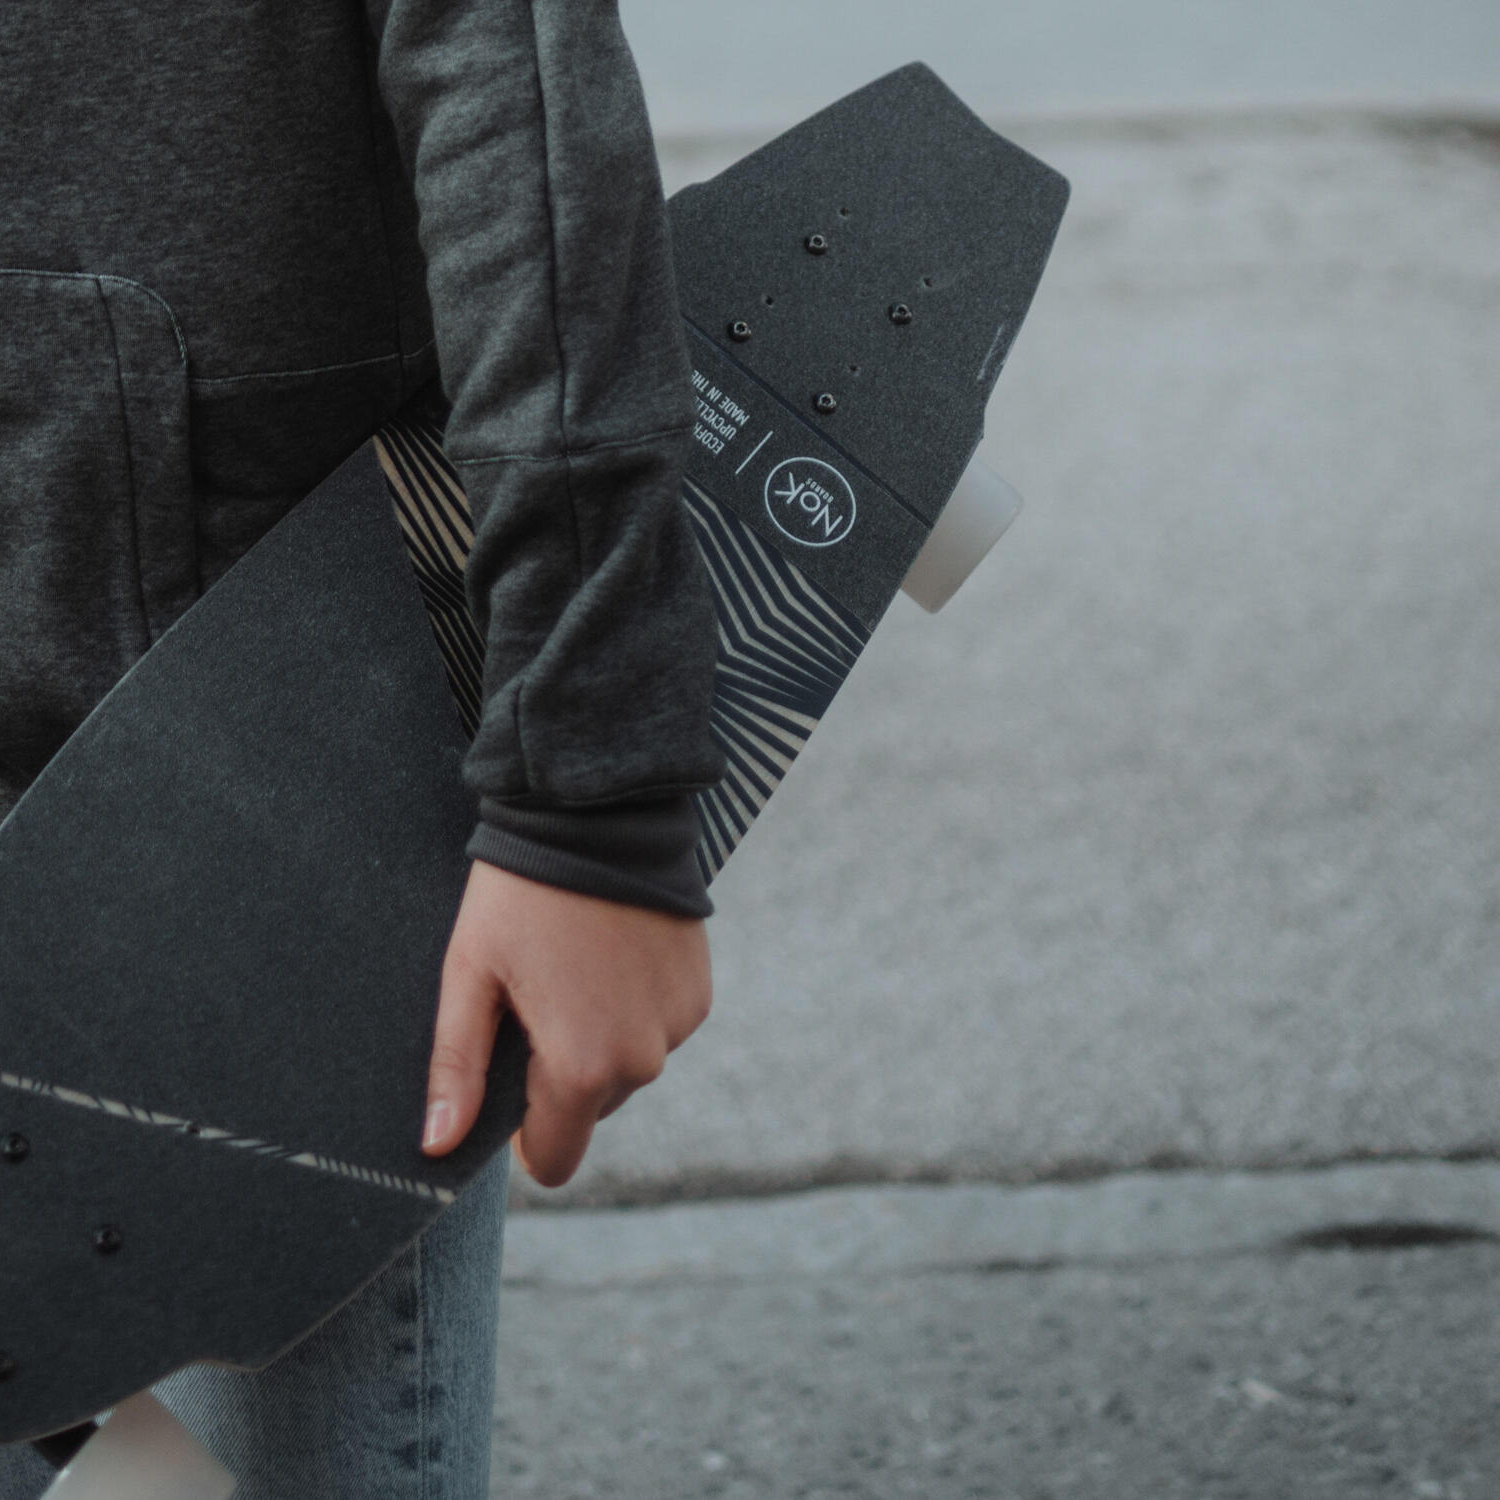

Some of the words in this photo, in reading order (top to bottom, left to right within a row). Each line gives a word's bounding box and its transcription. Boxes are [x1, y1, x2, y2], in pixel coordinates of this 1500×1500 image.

[706, 386, 723, 404] IN
[718, 396, 751, 427] MADE
[805, 477, 835, 504] BOARDS
